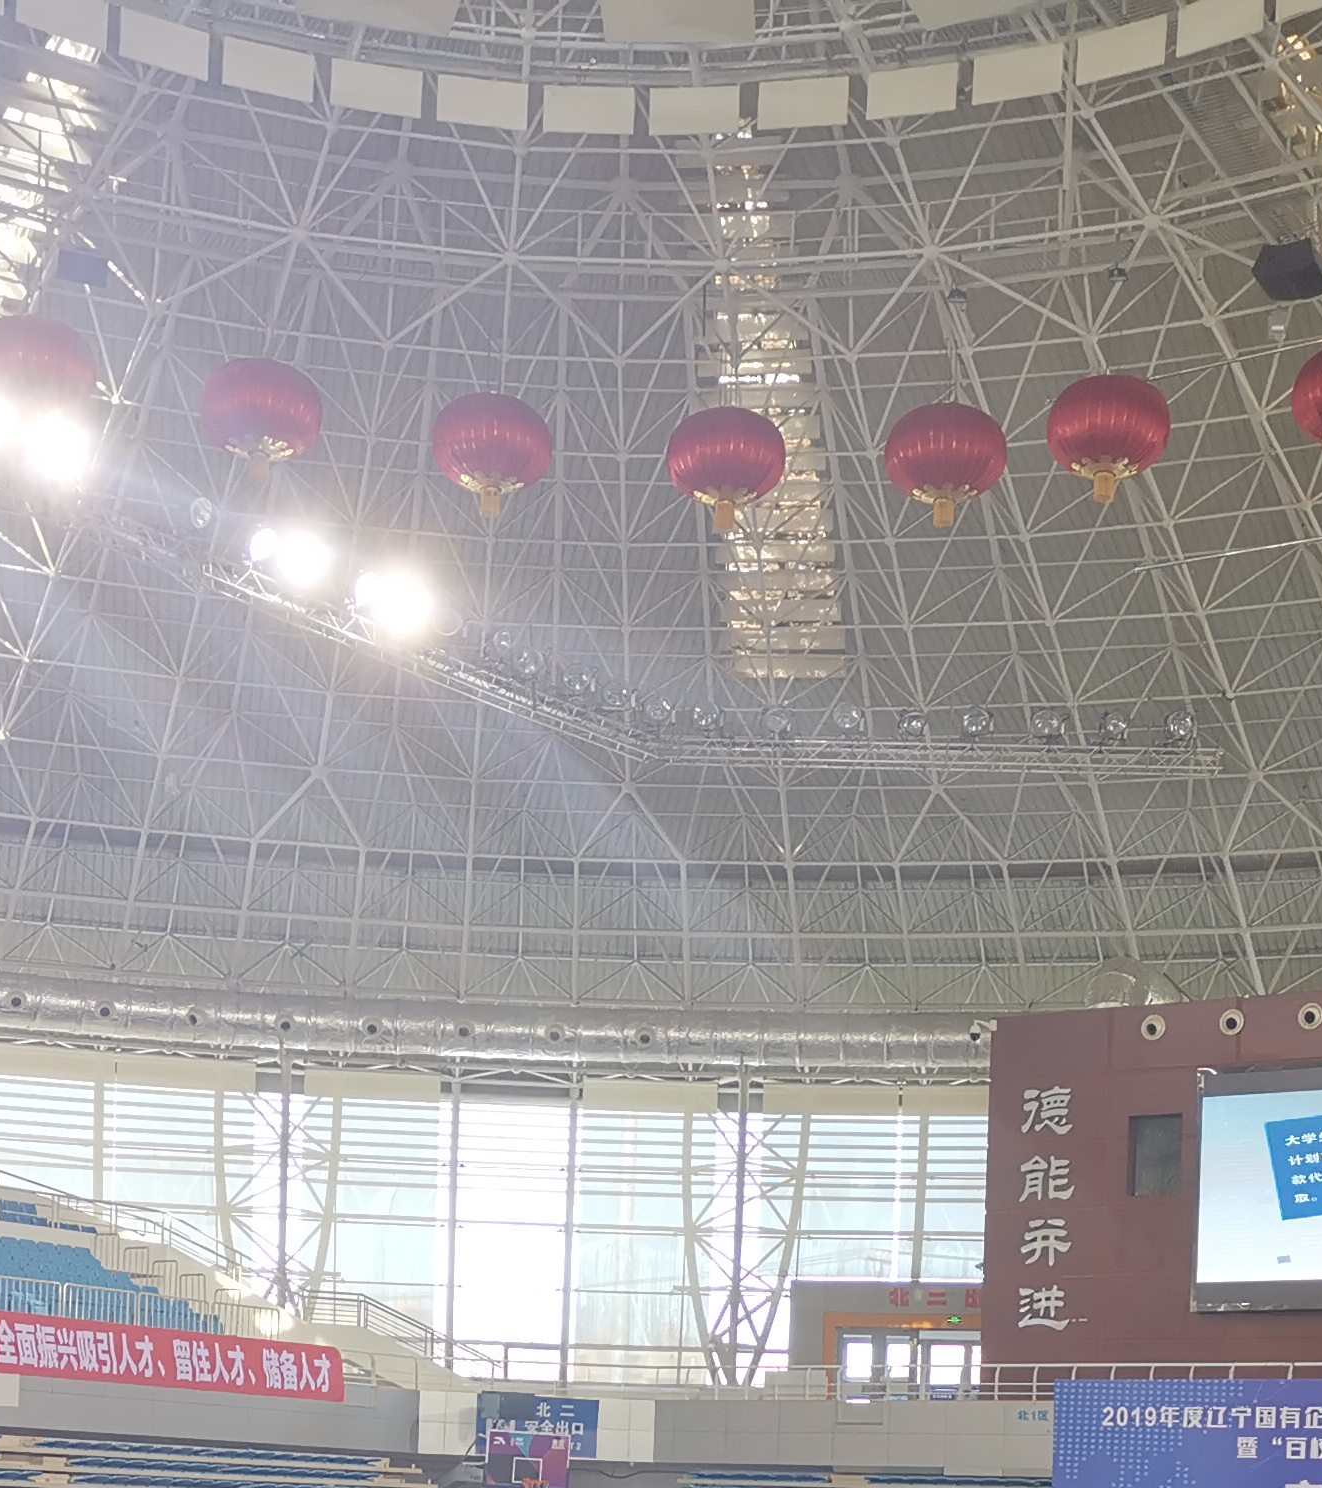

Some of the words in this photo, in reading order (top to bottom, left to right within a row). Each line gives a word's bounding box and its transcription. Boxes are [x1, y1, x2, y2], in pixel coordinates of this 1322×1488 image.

[1018, 1086, 1074, 1331] 德能并进
[535, 1402, 575, 1418] 北二
